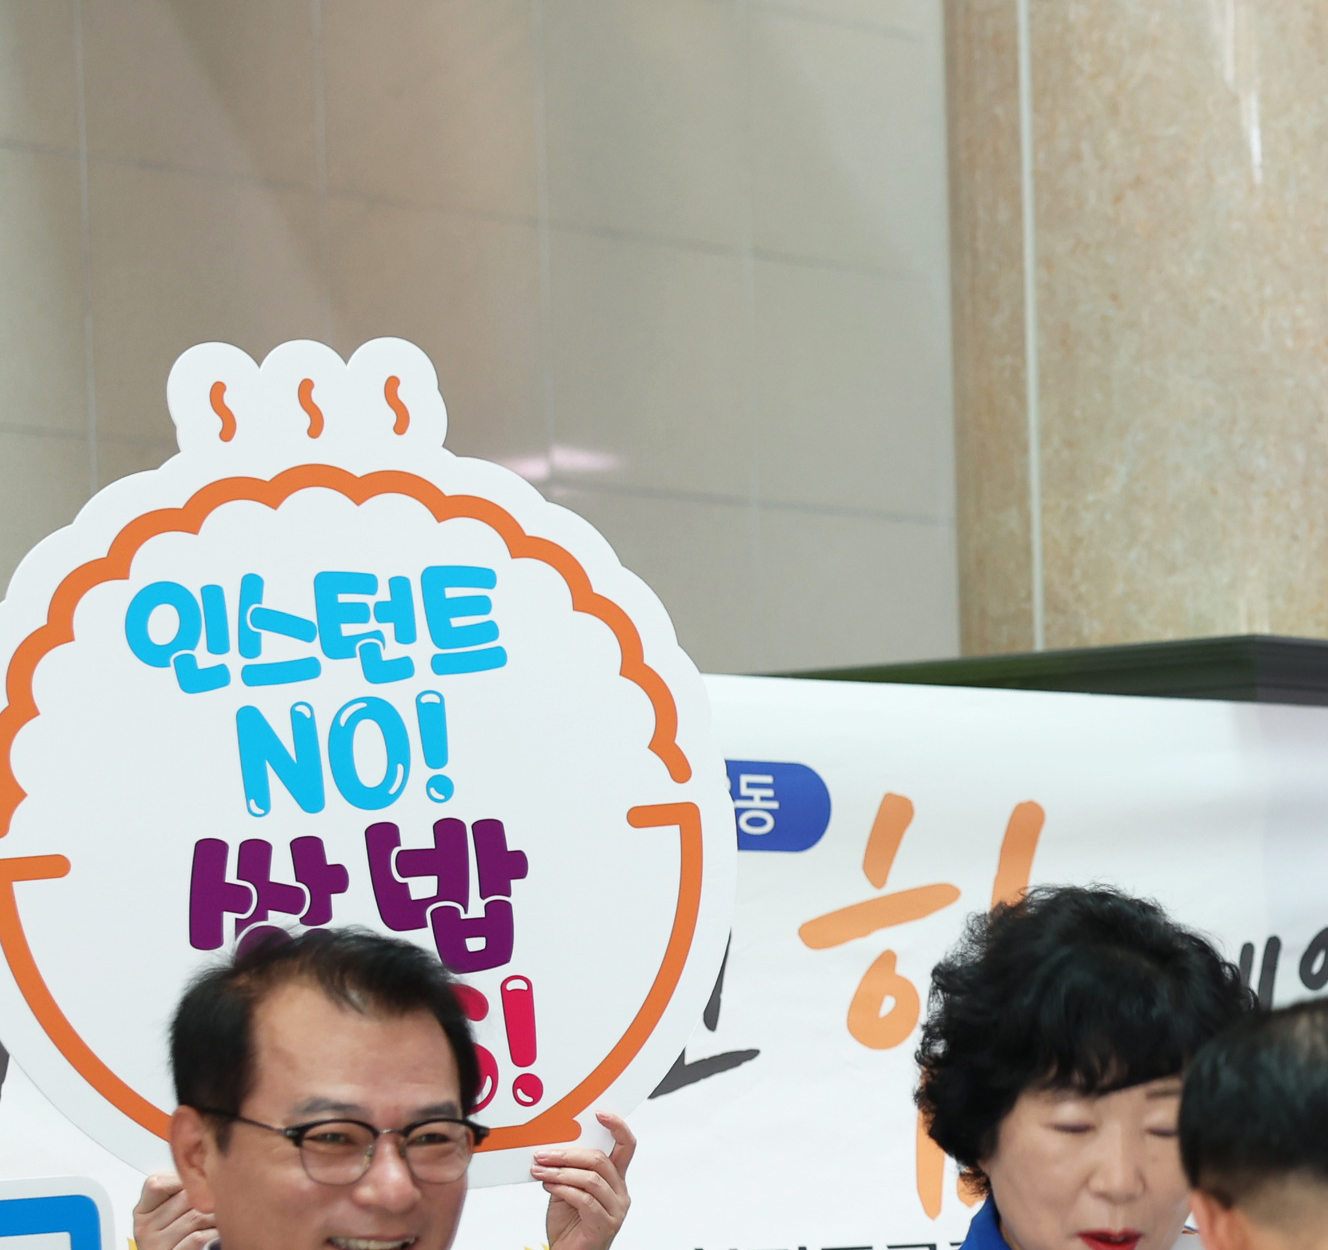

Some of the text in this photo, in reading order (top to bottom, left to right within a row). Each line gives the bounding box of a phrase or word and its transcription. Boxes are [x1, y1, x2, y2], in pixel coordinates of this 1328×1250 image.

[125, 566, 507, 694] 인스턴트
[236, 690, 454, 818] NO!
[727, 774, 781, 836] 동
